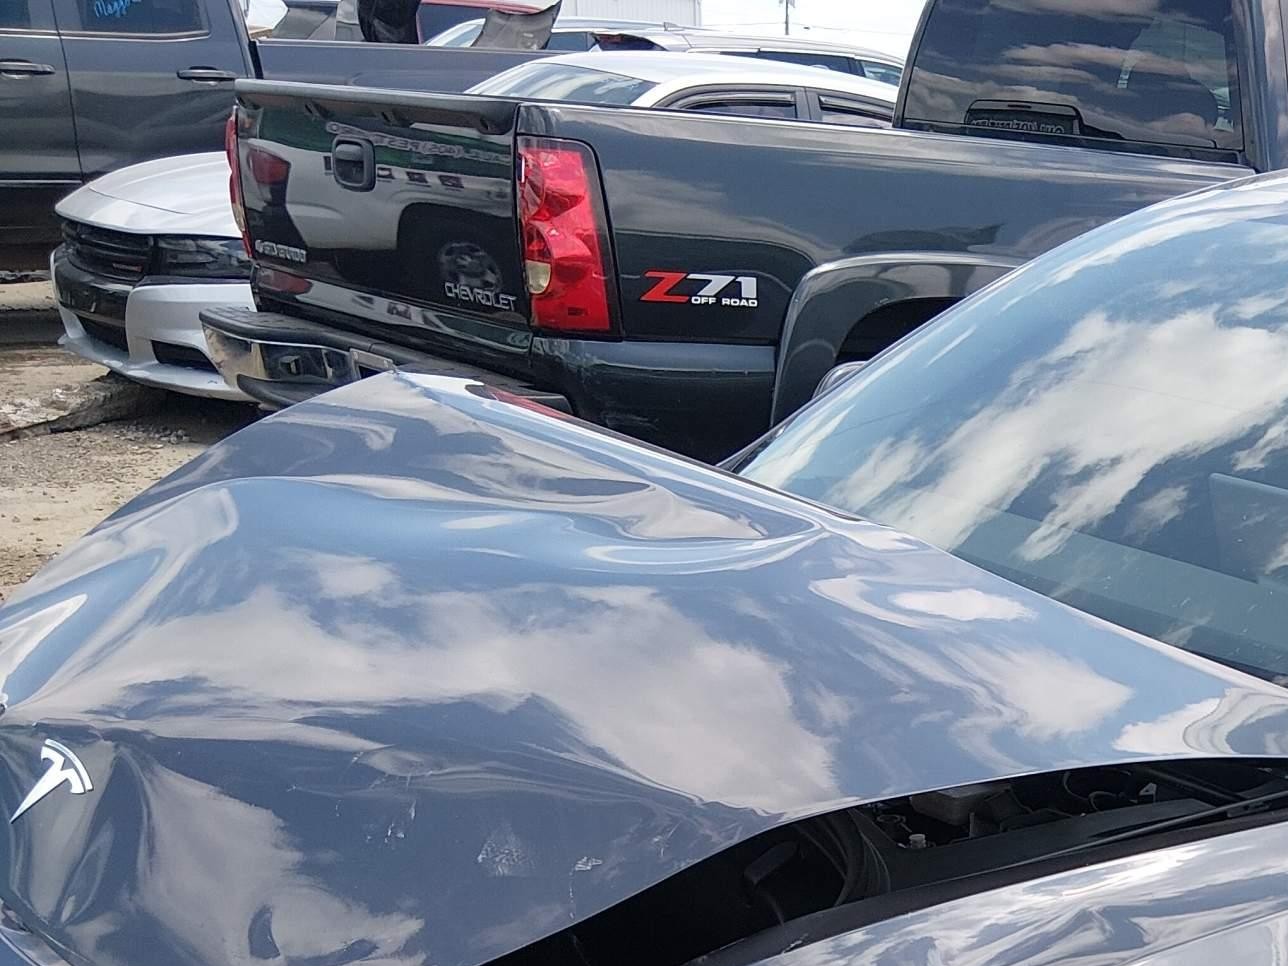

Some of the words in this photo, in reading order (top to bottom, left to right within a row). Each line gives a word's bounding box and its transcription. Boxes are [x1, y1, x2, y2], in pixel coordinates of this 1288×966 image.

[444, 281, 517, 311] CHEVROLET
[640, 271, 757, 303] Z71
[691, 296, 717, 305] OFF
[721, 297, 758, 307] ROAD
